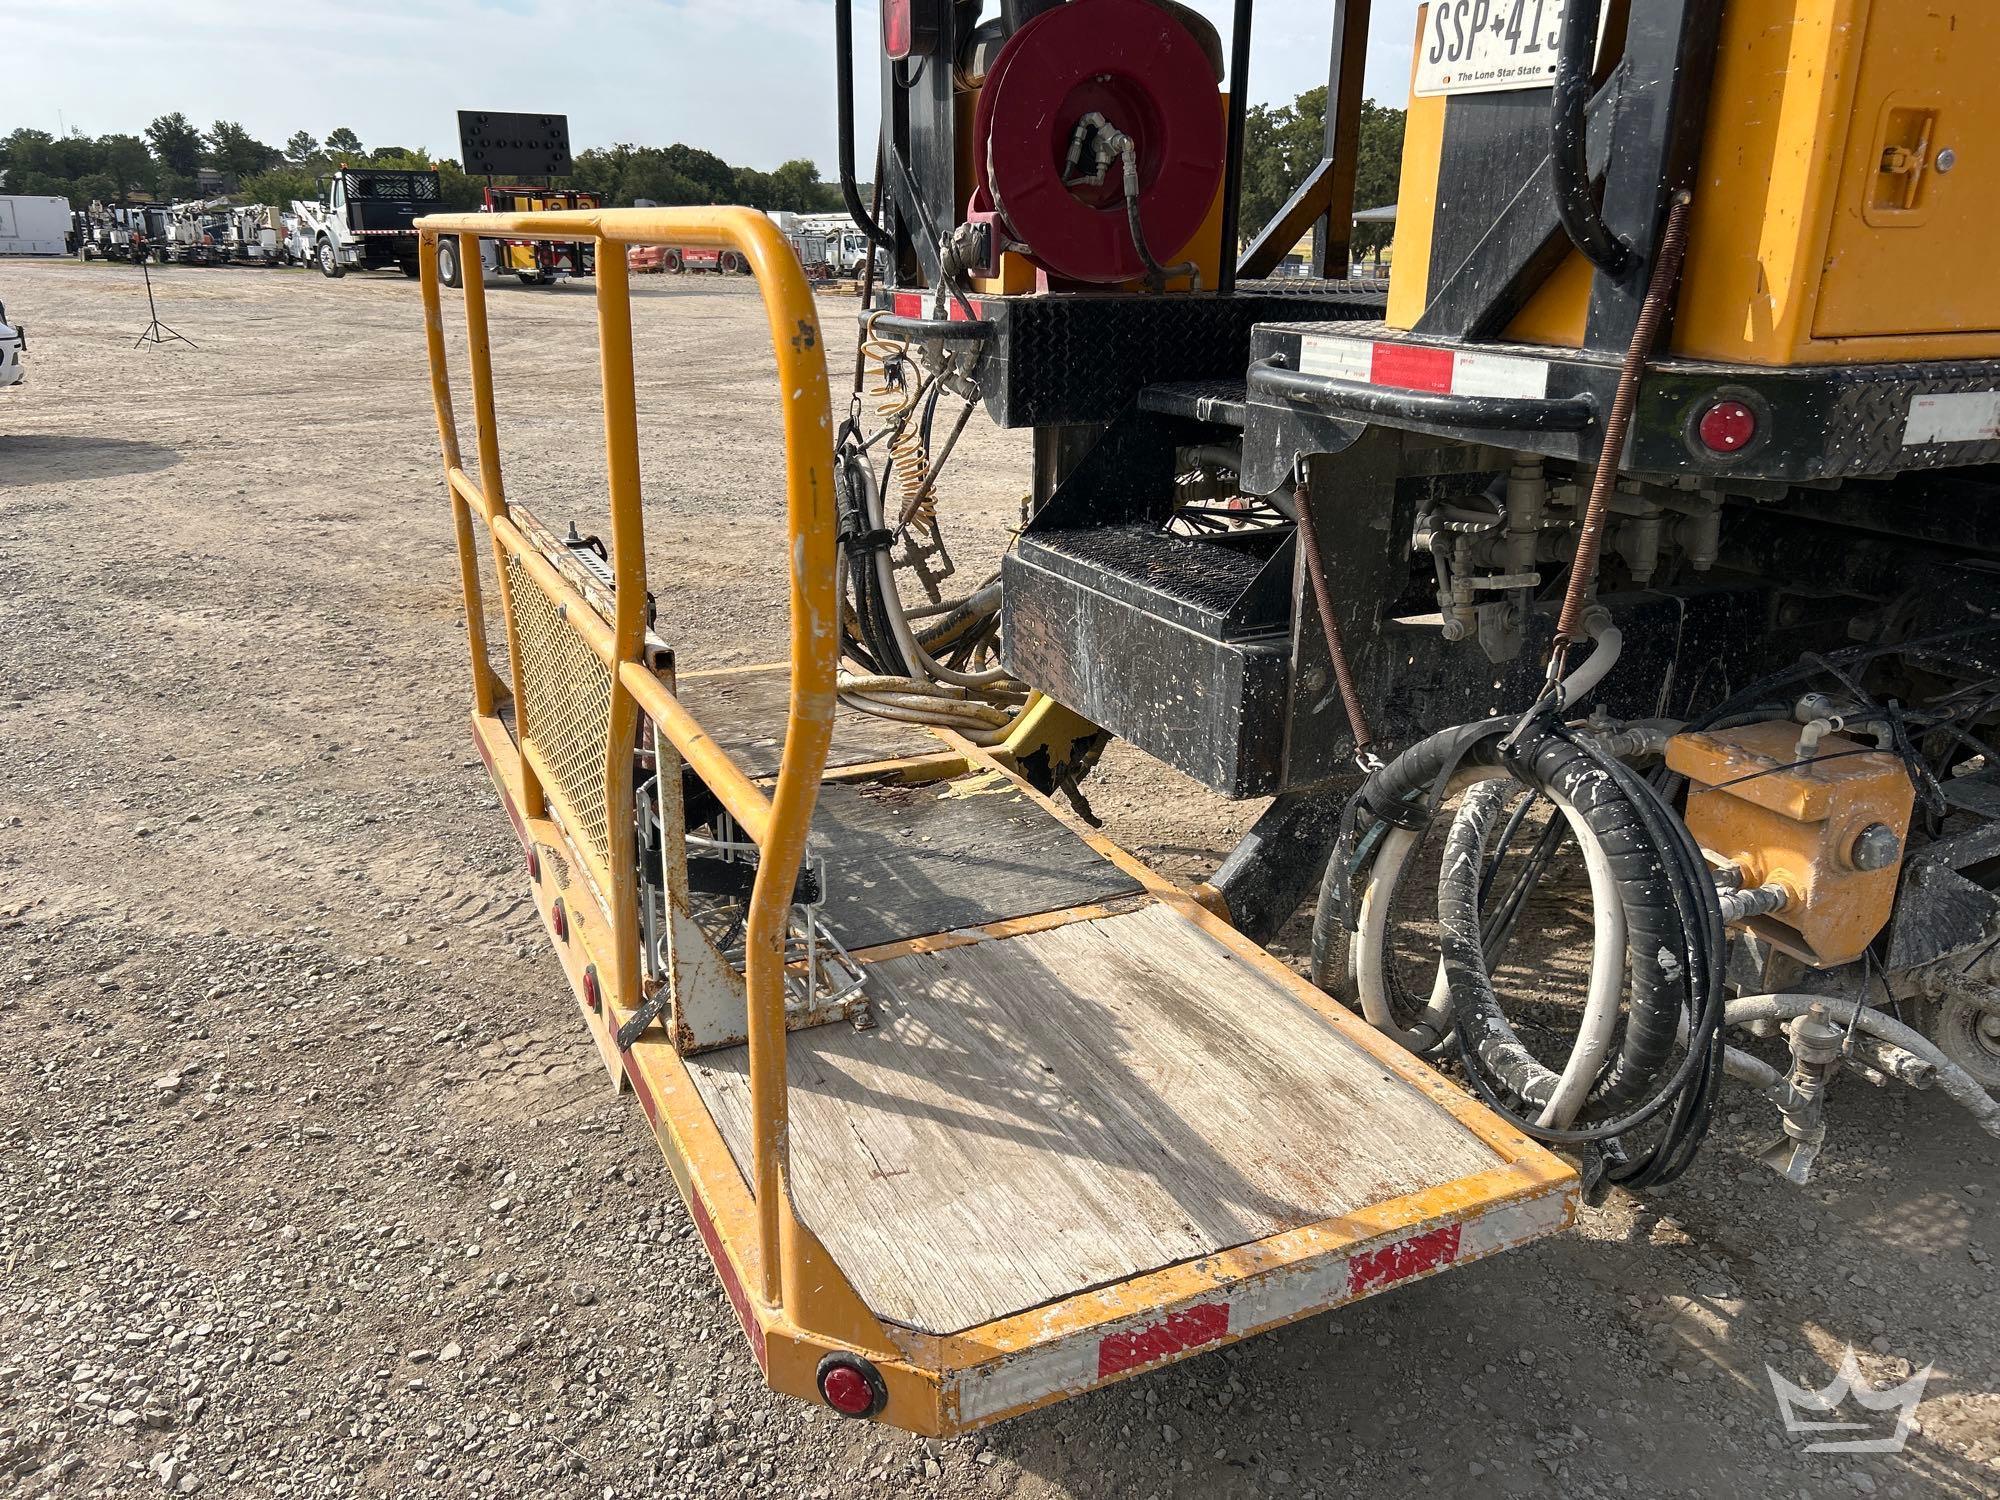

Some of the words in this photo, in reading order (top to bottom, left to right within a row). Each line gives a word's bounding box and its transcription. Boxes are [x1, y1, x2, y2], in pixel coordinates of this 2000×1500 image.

[1429, 0, 1490, 65] SSP
[1458, 72, 1473, 81] The
[1474, 71, 1495, 80] Lone
[1497, 68, 1516, 78] Star
[1517, 66, 1541, 76] State
